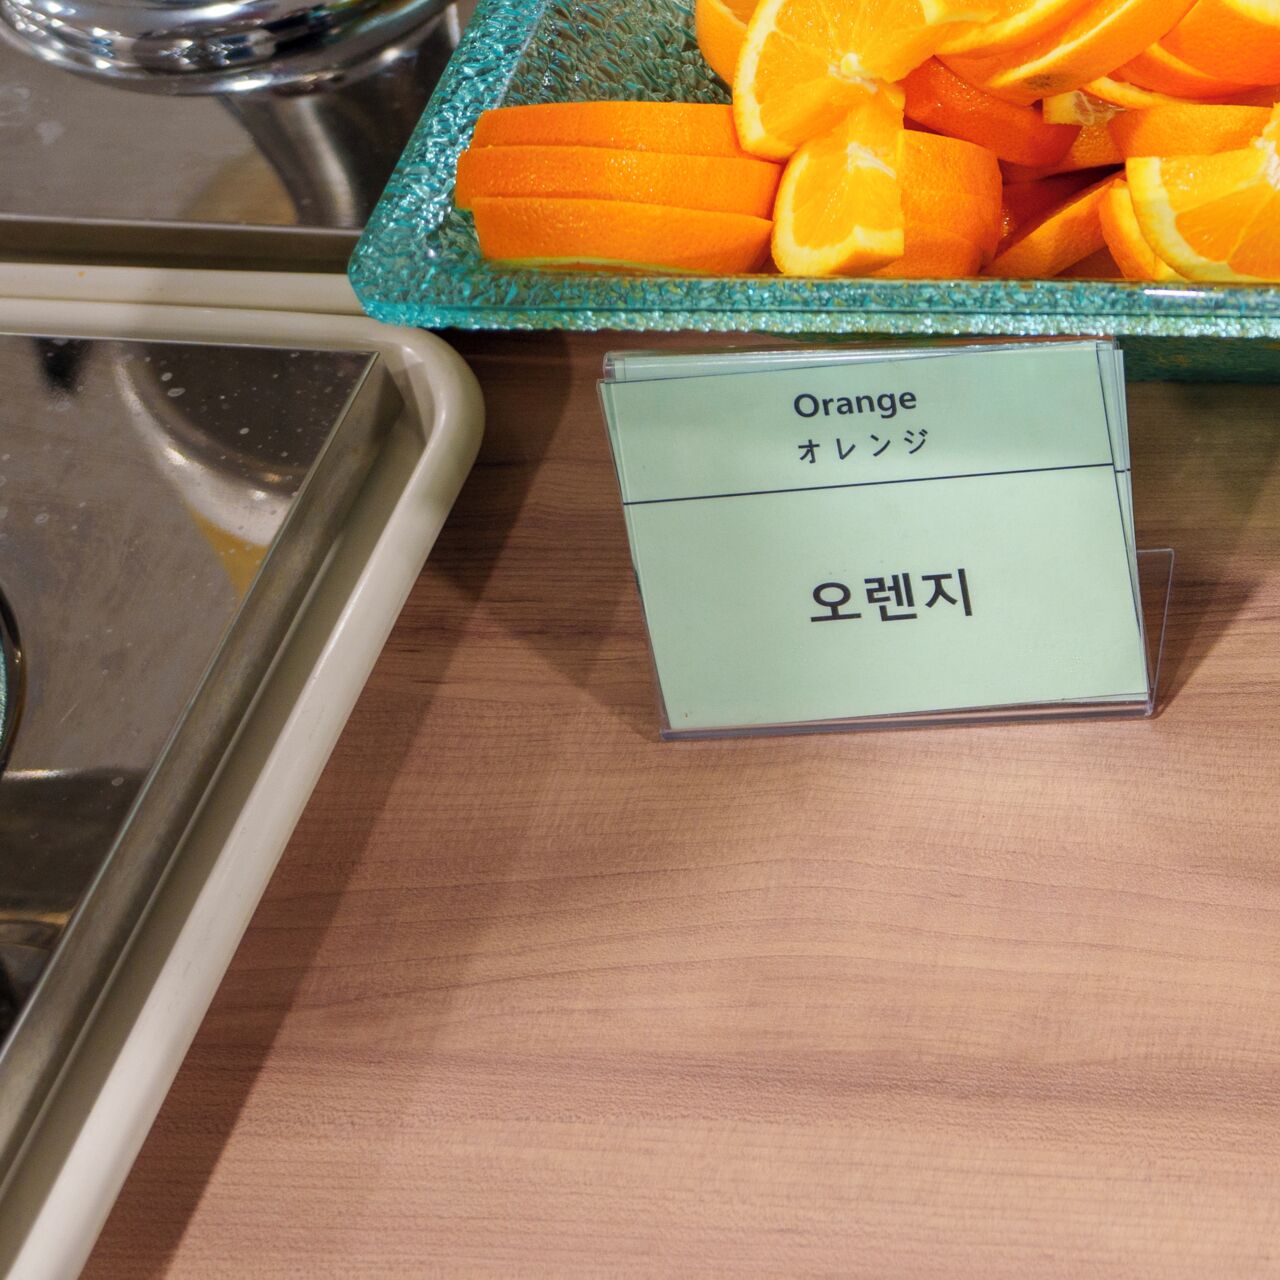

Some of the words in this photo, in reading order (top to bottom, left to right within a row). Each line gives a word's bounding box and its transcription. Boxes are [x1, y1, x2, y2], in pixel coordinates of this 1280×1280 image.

[793, 390, 917, 420] Orange
[797, 428, 929, 465] オレンジ
[810, 567, 973, 623] 오렌지
